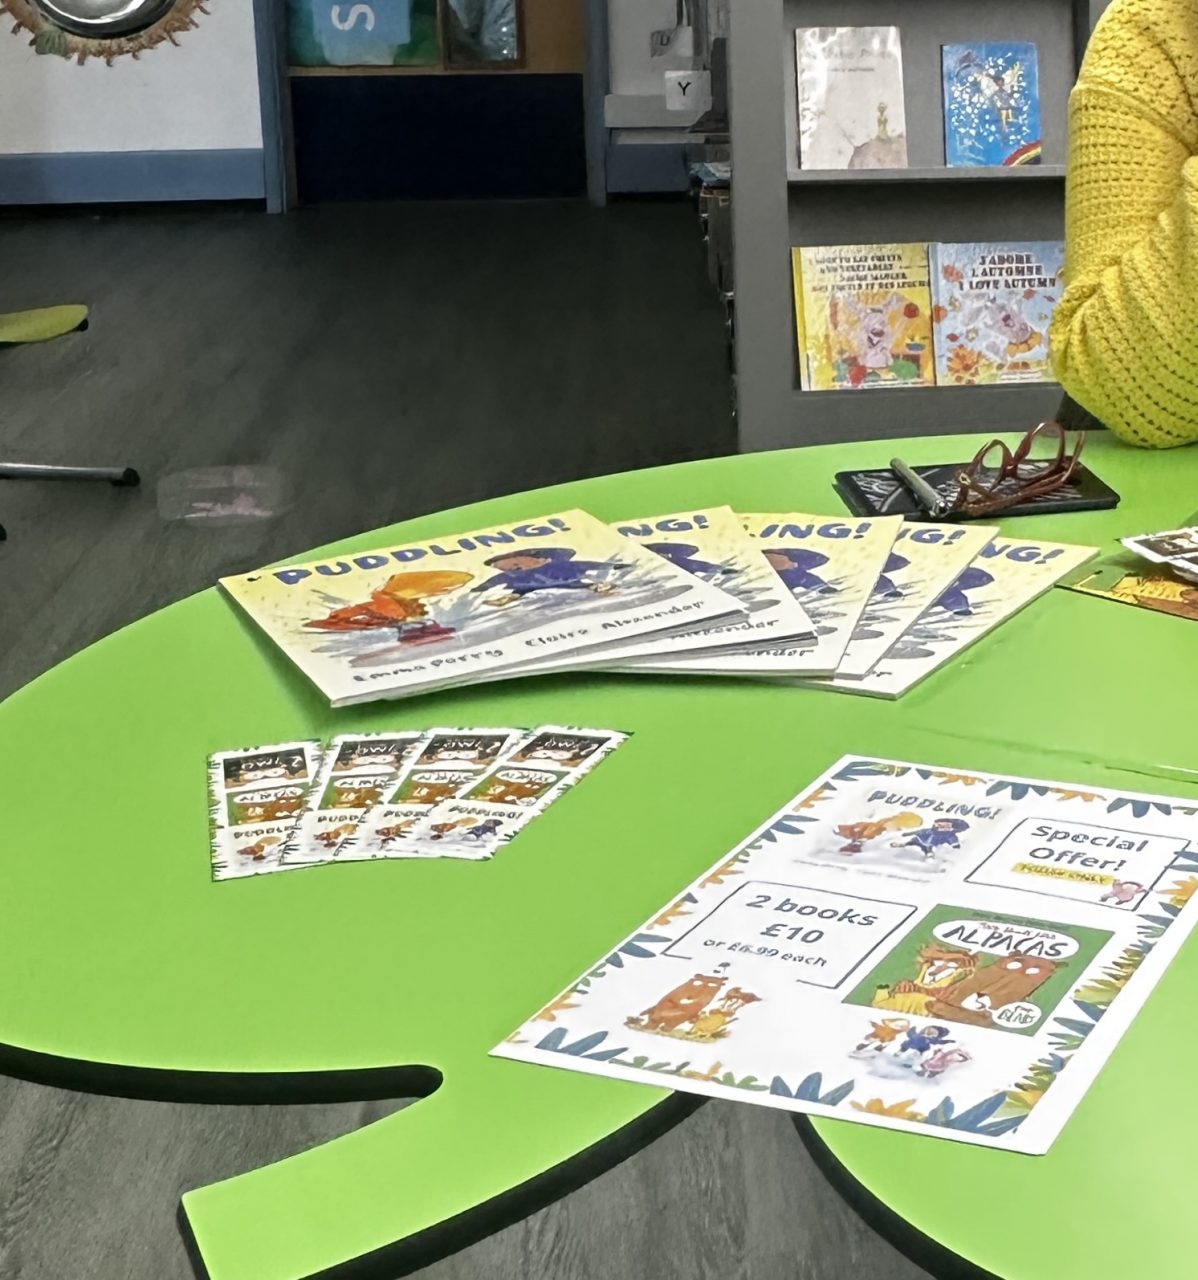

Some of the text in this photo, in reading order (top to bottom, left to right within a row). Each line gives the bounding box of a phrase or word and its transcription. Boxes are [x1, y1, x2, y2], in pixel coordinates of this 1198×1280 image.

[677, 81, 692, 96] Y
[749, 522, 873, 540] ING!
[272, 517, 572, 586] PUDDLING!
[352, 662, 427, 682] Emma
[430, 646, 504, 668] Perry
[867, 789, 1003, 820] PUDDLING!
[1031, 822, 1150, 854] Special
[1028, 846, 1127, 873] Offer!
[745, 894, 878, 927] 2 books
[760, 922, 825, 944] £10
[941, 924, 1069, 958] ALPACAS
